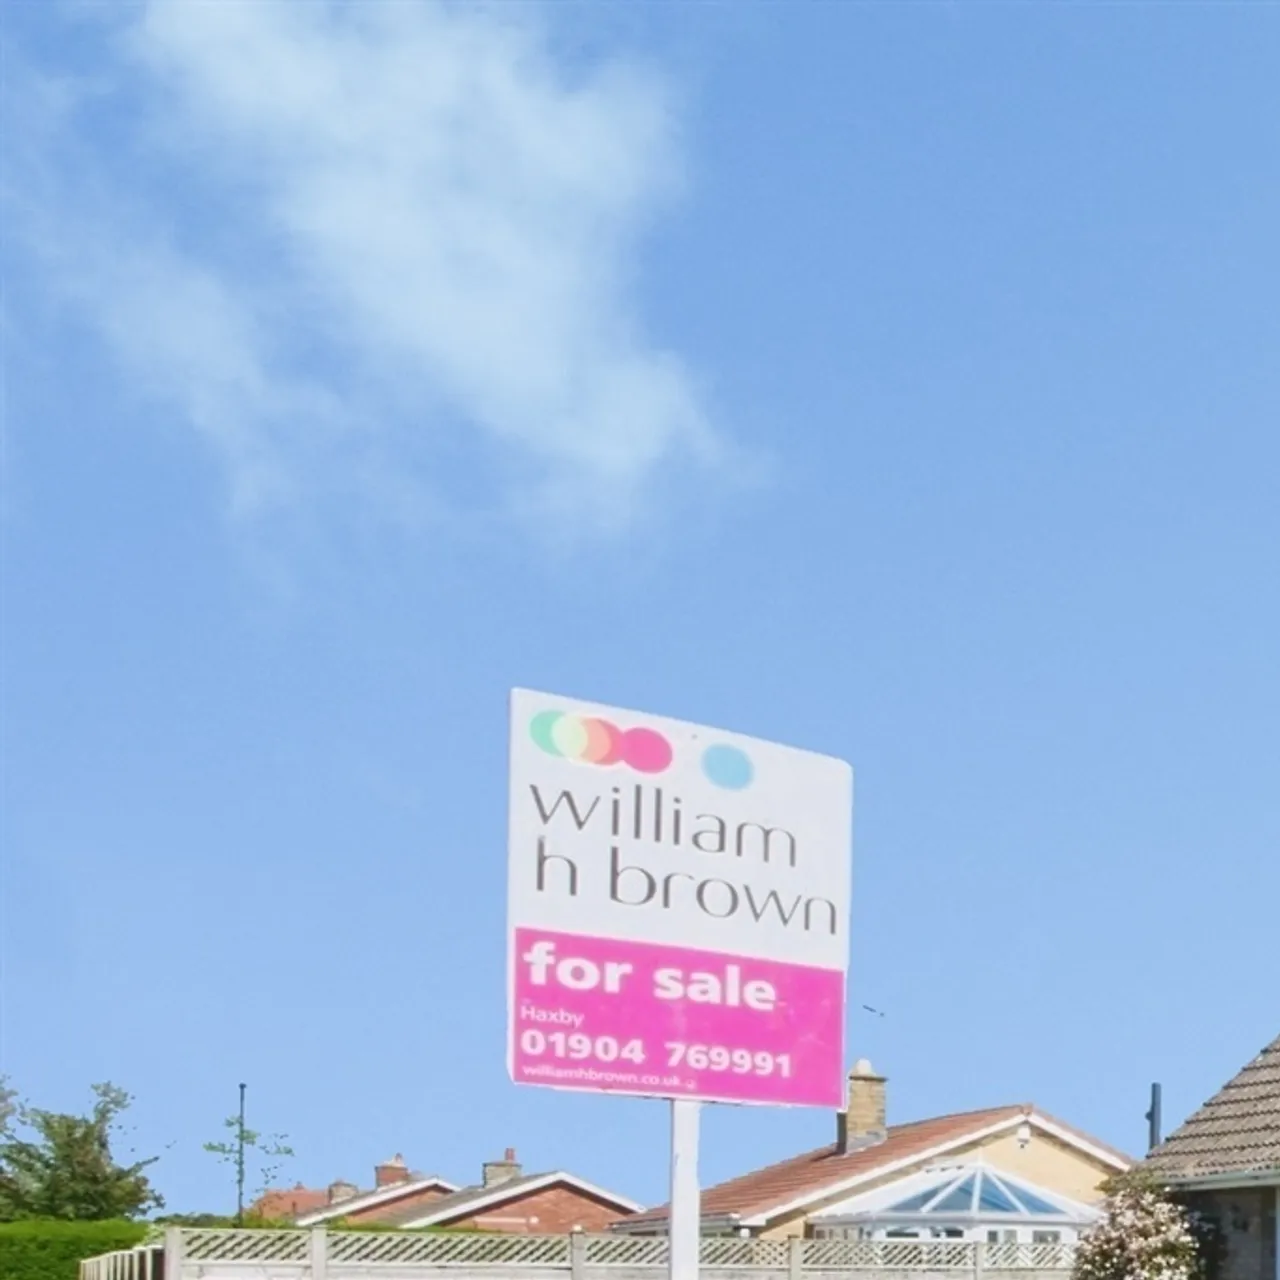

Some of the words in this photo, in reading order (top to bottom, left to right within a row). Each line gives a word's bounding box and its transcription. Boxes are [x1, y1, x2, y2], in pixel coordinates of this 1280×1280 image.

[529, 783, 796, 867] william
[536, 834, 578, 896] h
[609, 846, 838, 935] brown
[523, 940, 633, 993] for
[653, 964, 777, 1011] sale
[521, 1005, 584, 1027] Haxby
[521, 1030, 646, 1064] 01904
[666, 1041, 791, 1077] 769991
[523, 1063, 681, 1089] williamhbrown.co.uk
